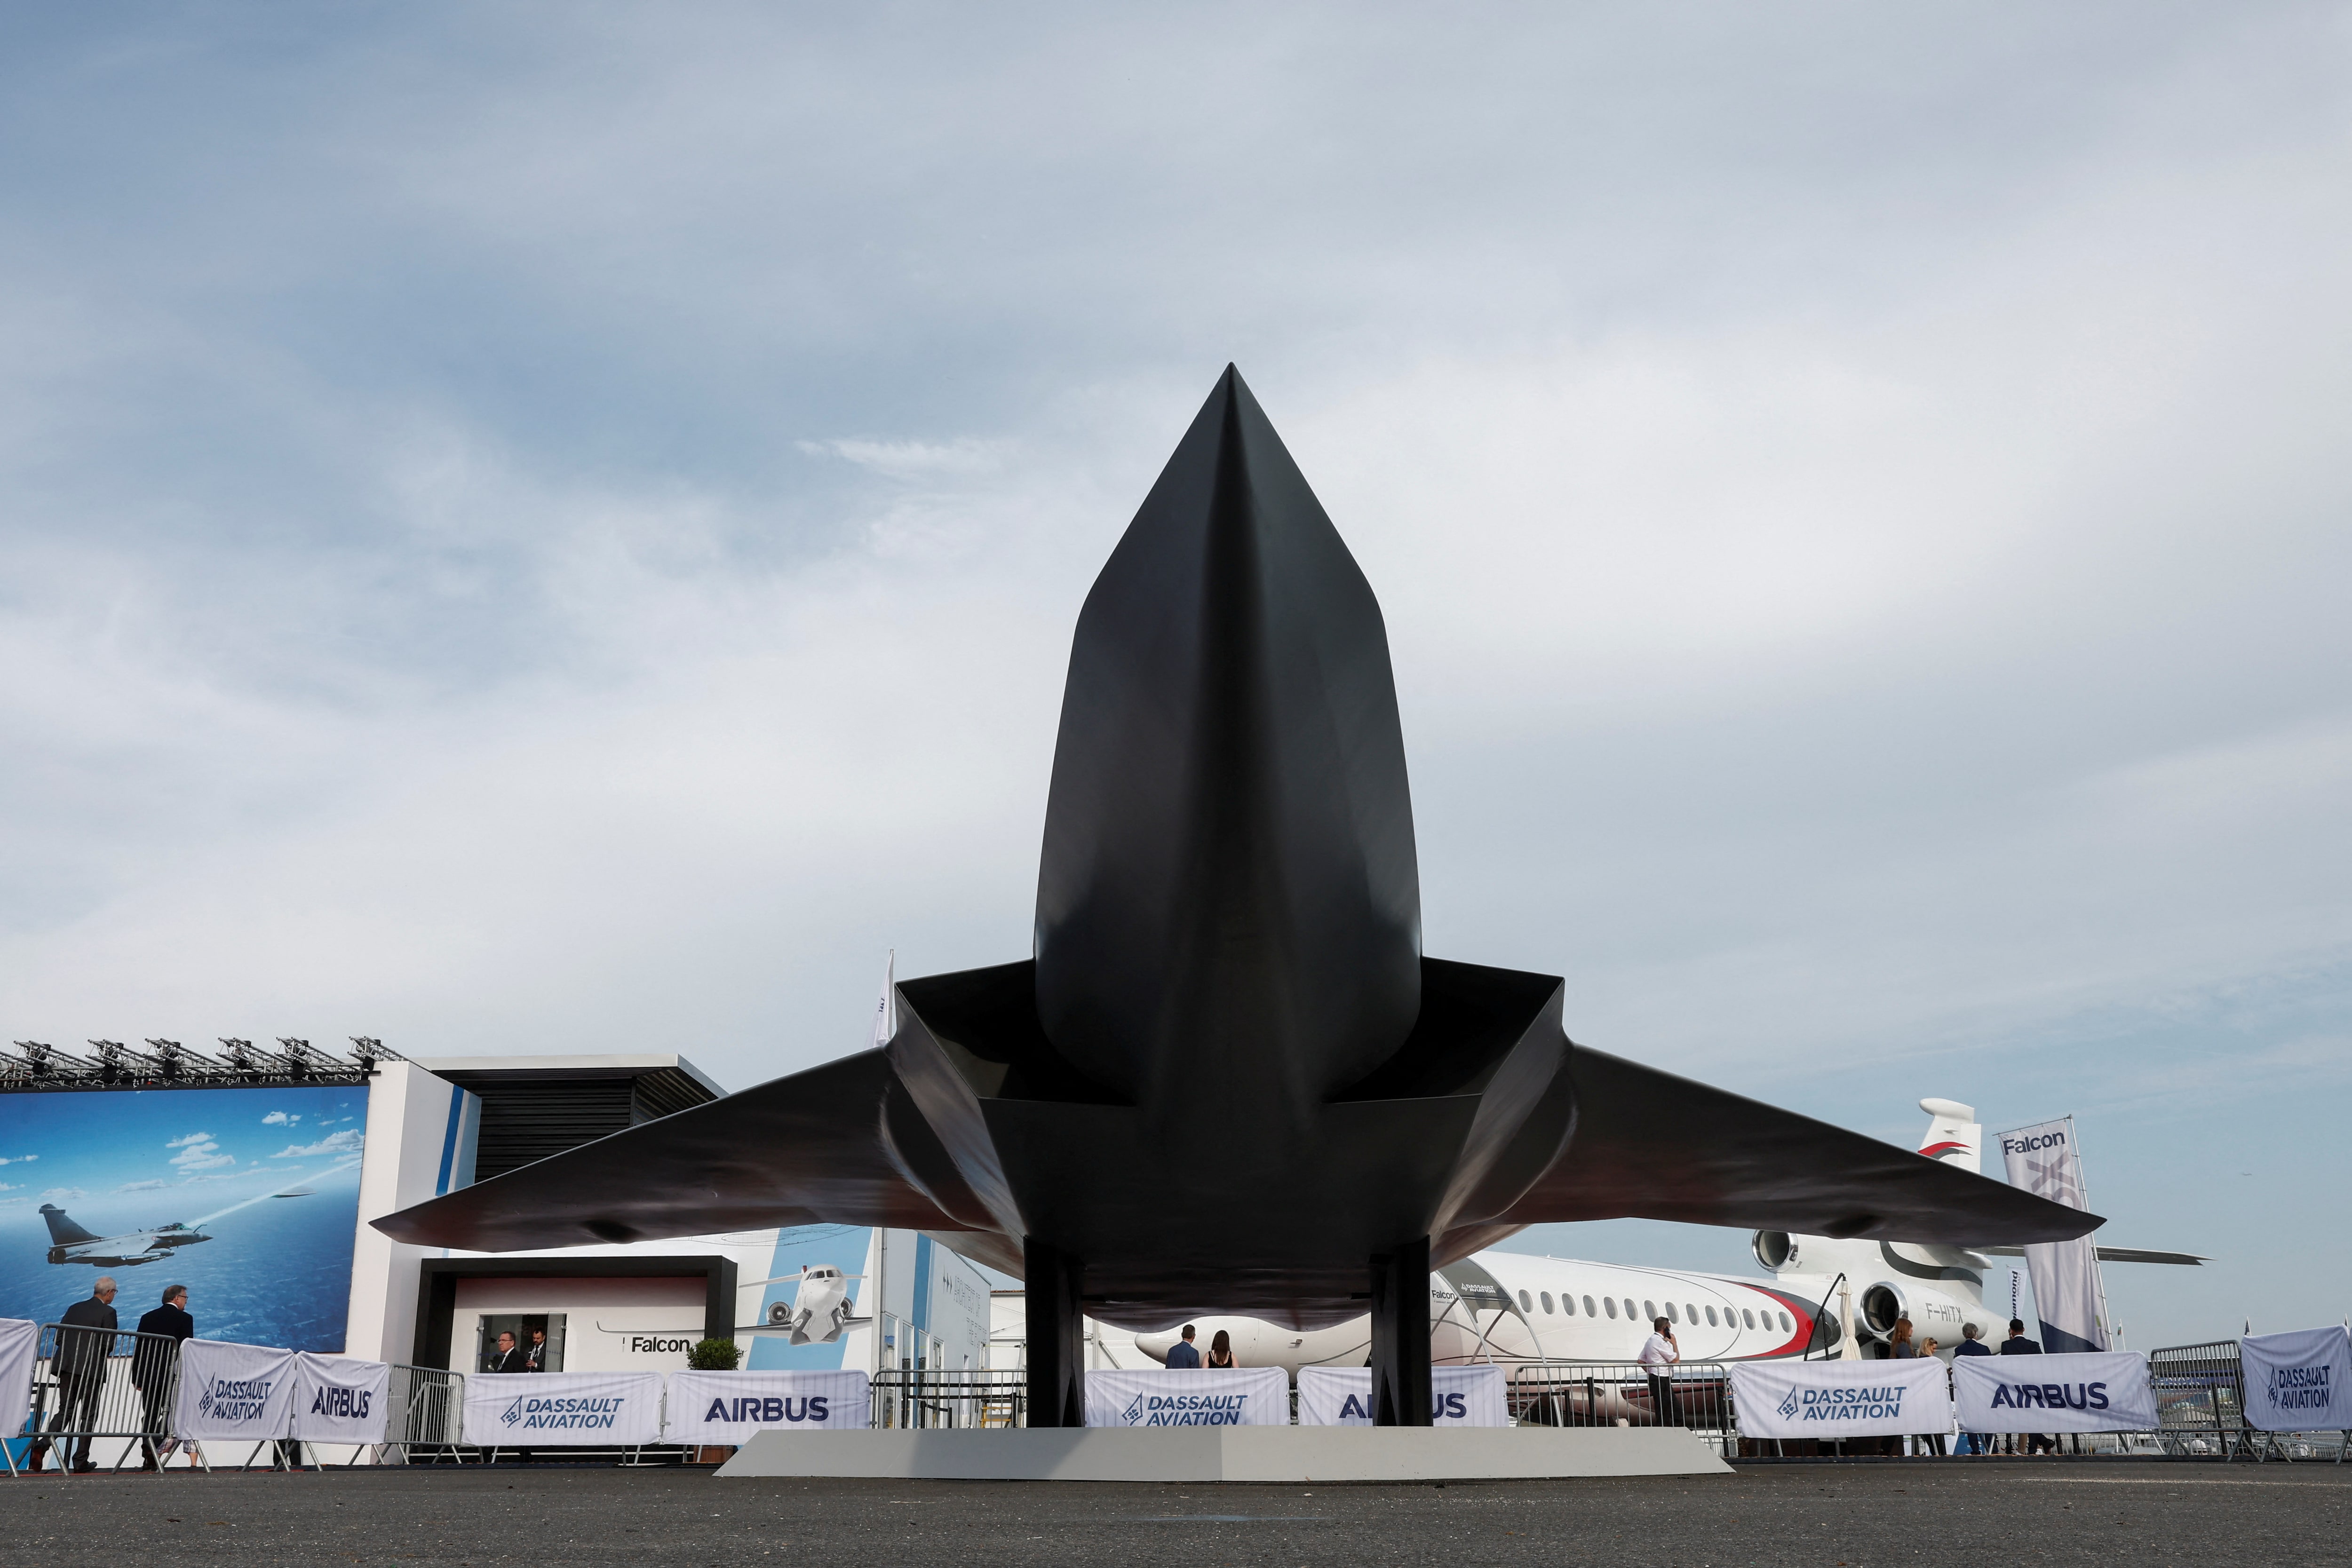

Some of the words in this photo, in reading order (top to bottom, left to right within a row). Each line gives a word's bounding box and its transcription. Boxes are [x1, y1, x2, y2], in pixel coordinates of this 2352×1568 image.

[2003, 1132, 2066, 1156] Falcon
[954, 1275, 975, 1314] ARCHITECT
[975, 1292, 981, 1317] OF
[1431, 1290, 1456, 1300] Falcon
[1925, 1302, 1963, 1324] F-HITX
[632, 1336, 690, 1353] Falcon
[2279, 1365, 2330, 1388] DASSAULT
[215, 1380, 271, 1400] DASSAULT
[1803, 1386, 1907, 1404] DASSAULT
[1991, 1382, 2109, 1410] AIRBUS
[2282, 1388, 2329, 1409] AVIATION
[212, 1402, 265, 1419] AVIATION
[311, 1386, 372, 1418] AIRBUS
[526, 1398, 625, 1413] DASSAULT
[704, 1396, 829, 1422] AIRBUS
[1147, 1395, 1248, 1410] DASSAULT
[1803, 1403, 1900, 1420] AVIATION
[523, 1414, 615, 1428] AVIATION
[1146, 1411, 1240, 1426] AVIATION
